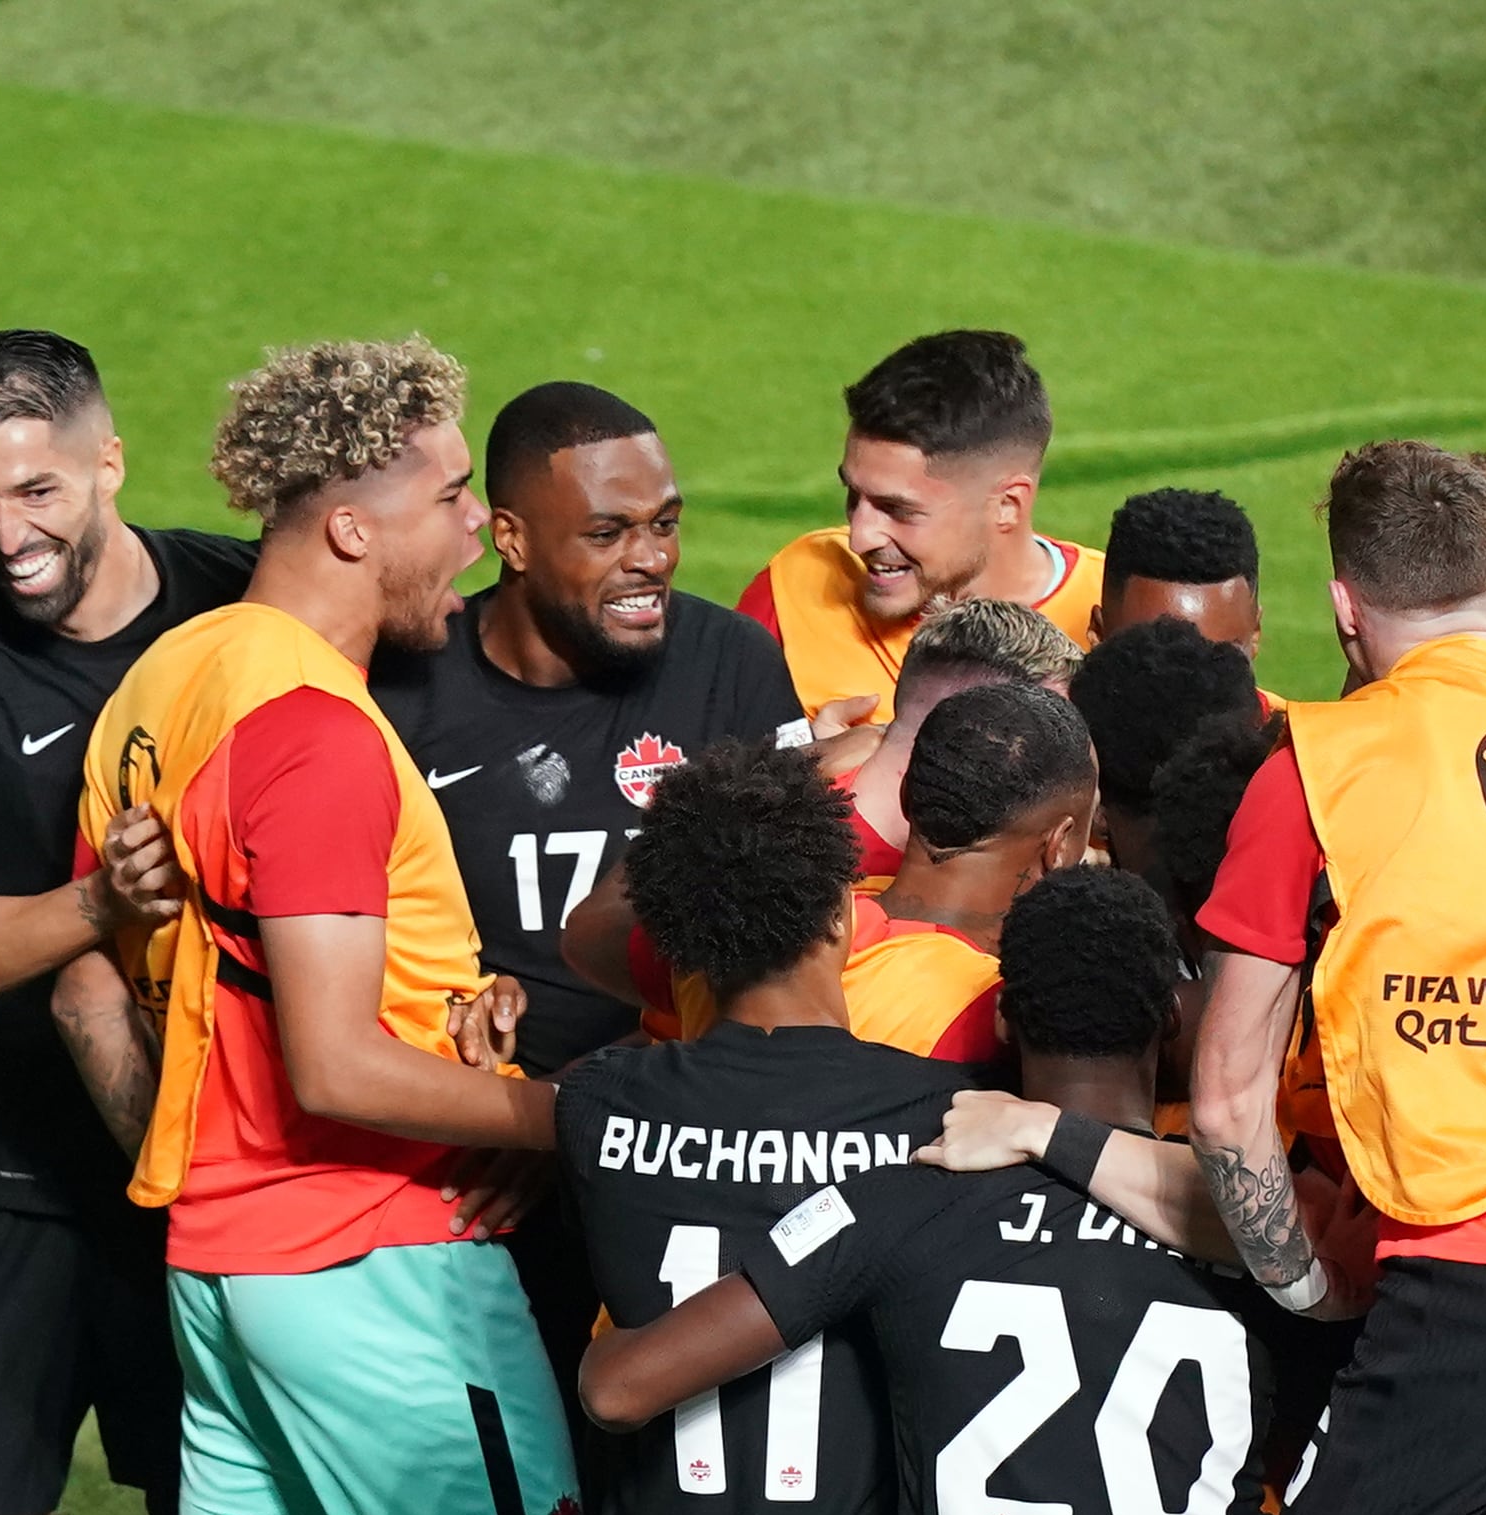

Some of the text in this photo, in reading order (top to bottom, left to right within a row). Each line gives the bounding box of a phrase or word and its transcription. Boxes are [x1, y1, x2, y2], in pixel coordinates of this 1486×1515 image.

[619, 767, 663, 781] CAN
[508, 830, 608, 931] 17
[1383, 974, 1460, 1004] FIFA
[598, 1115, 910, 1184] BUCHANAN
[998, 1193, 1053, 1243] J.
[658, 1225, 824, 1501] 11
